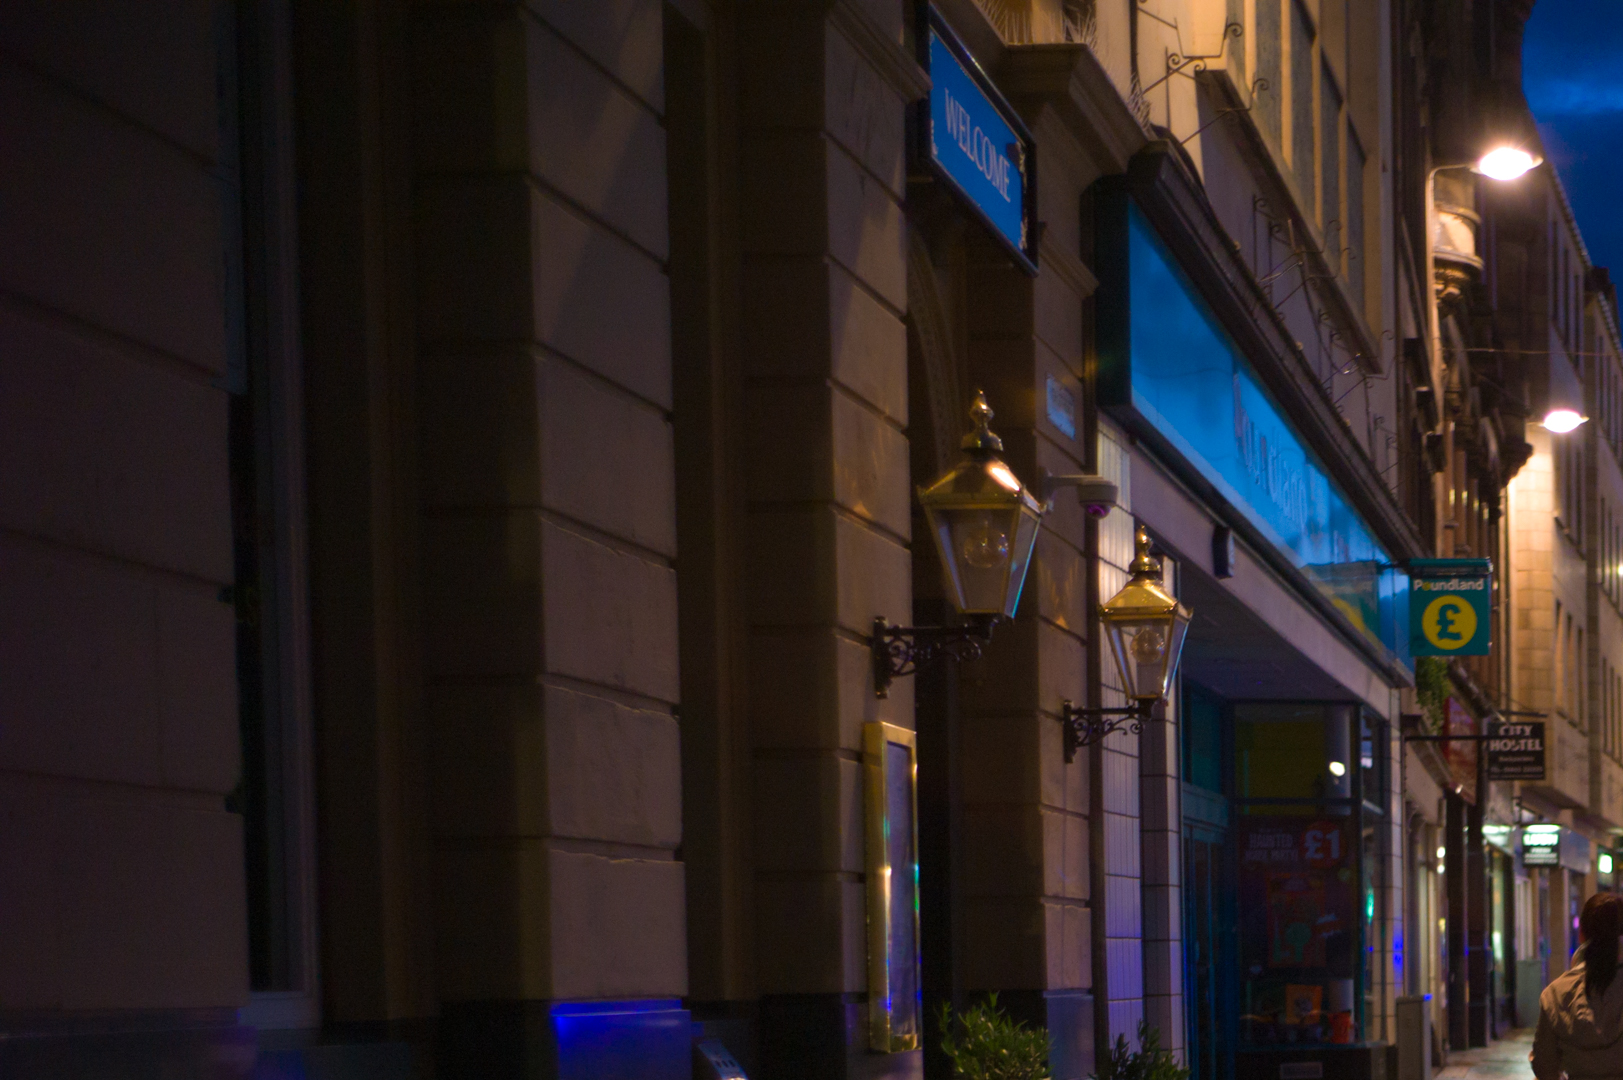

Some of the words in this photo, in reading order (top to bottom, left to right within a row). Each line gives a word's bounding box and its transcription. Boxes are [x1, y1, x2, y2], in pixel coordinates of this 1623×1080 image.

[944, 87, 1011, 203] WELCOME
[1413, 578, 1485, 591] Poundland
[1499, 725, 1533, 736] CITY
[1490, 739, 1543, 751] HOSTEL
[1304, 829, 1341, 859] £1
